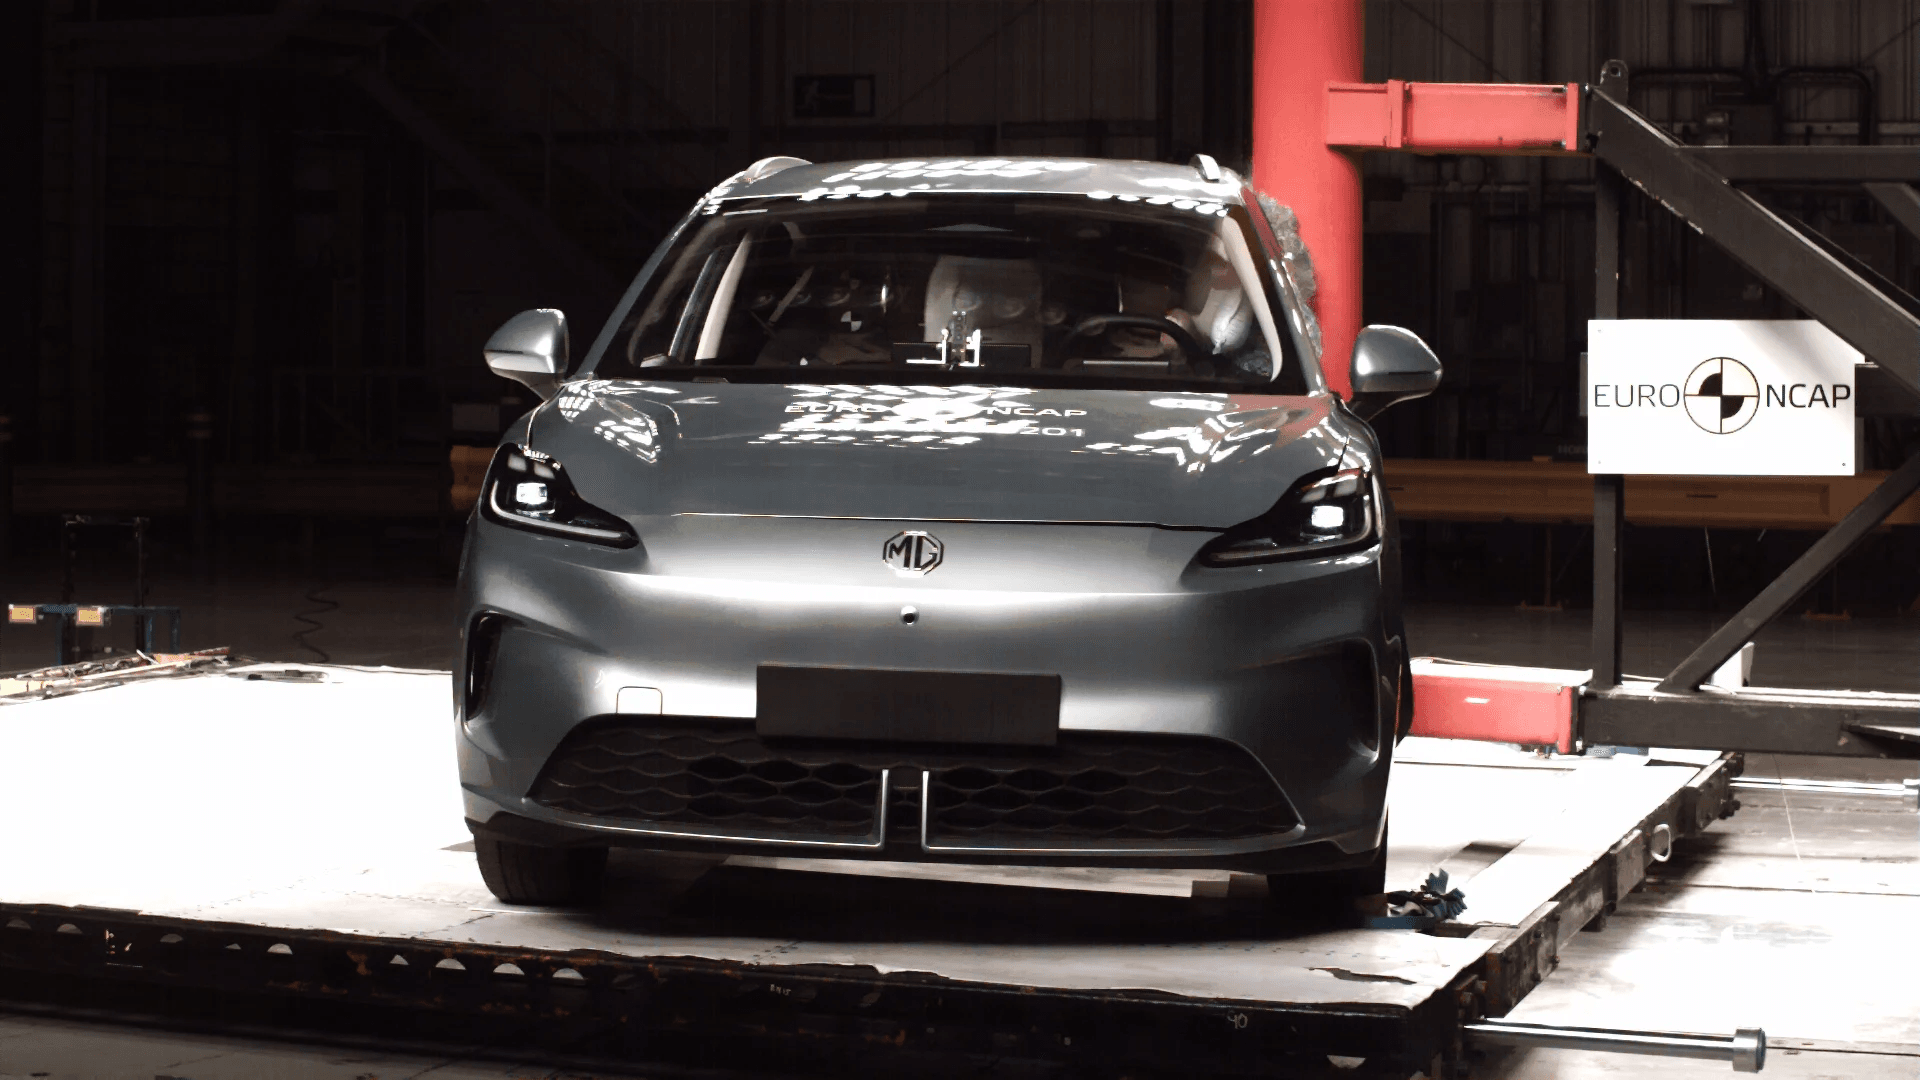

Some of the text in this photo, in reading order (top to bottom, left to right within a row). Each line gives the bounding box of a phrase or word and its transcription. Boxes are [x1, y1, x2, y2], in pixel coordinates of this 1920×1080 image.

[1594, 384, 1851, 408] EURO NCAP
[981, 406, 1088, 417] NCAP
[887, 535, 939, 571] MG
